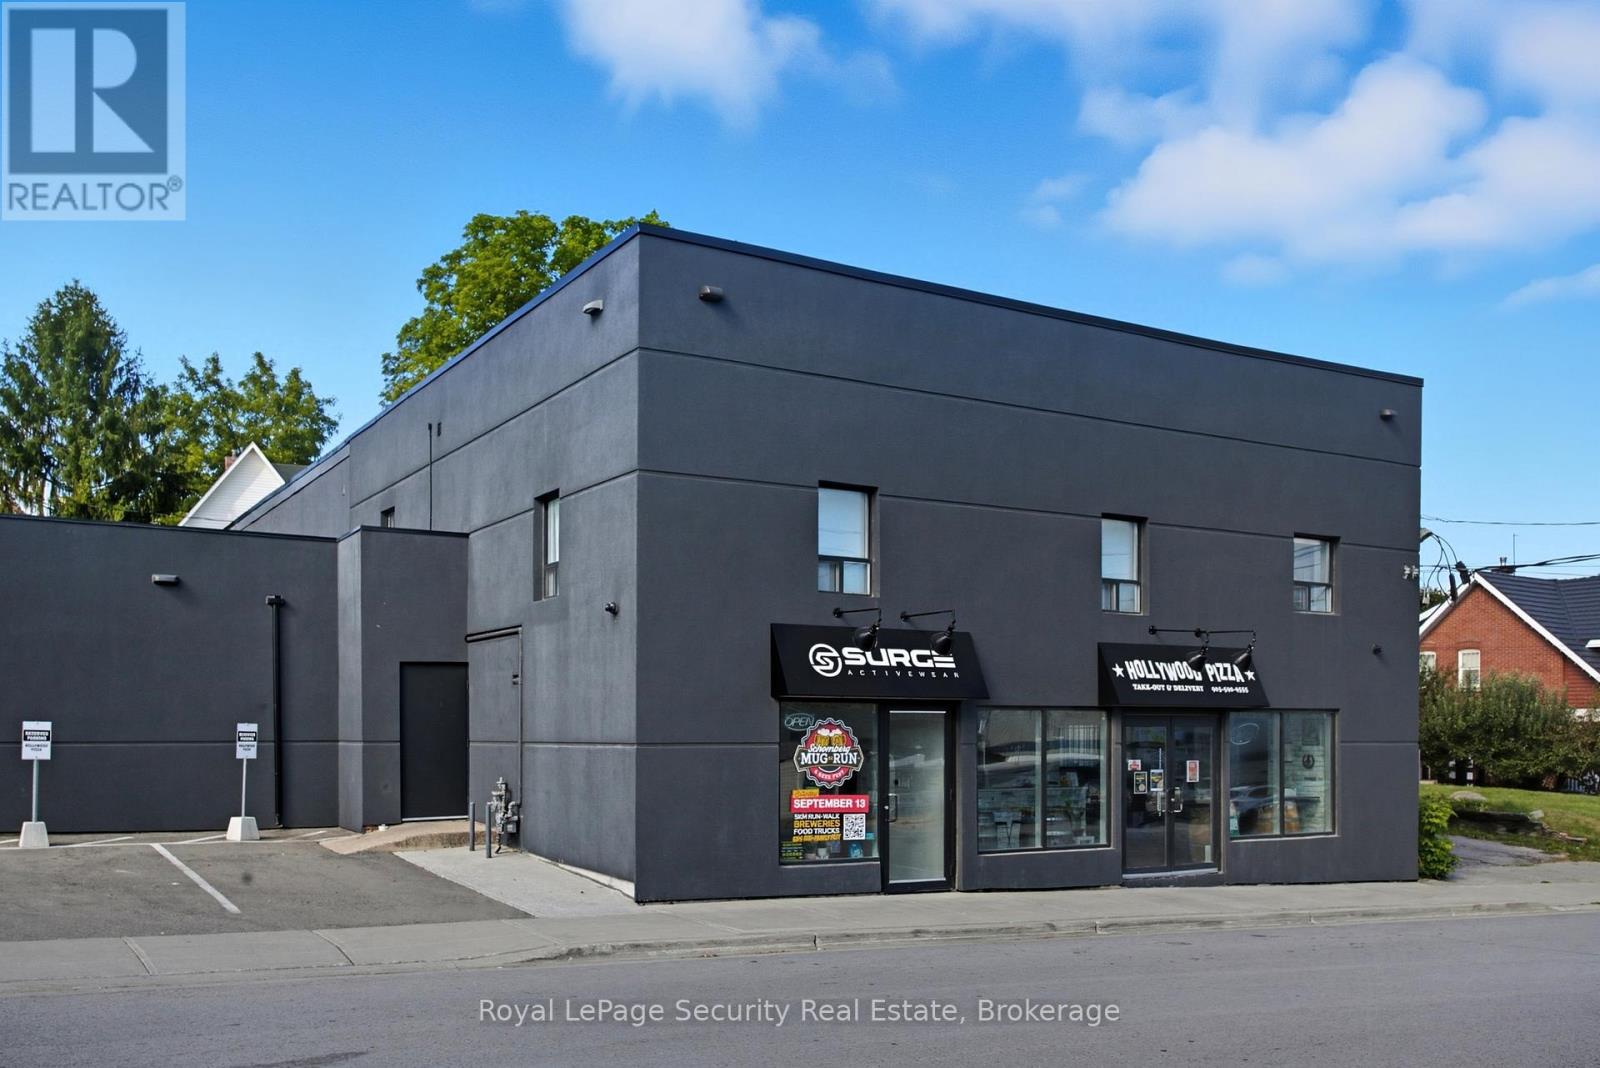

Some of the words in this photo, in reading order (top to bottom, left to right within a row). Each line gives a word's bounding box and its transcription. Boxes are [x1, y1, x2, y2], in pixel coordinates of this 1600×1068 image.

[842, 647, 956, 668] SURGE
[847, 669, 960, 678] ACTIVEWEAR
[1205, 662, 1245, 682] PIZZA
[1132, 683, 1165, 691] TAKE-OUT
[1173, 684, 1204, 692] DELIVERY
[784, 715, 815, 728] OPEN
[808, 744, 851, 756] Schomberg
[800, 752, 828, 765] MUG
[832, 752, 858, 765] RUN
[793, 798, 853, 809] SEPTEMBER
[855, 798, 866, 809] 13
[793, 819, 841, 828] BREWERIES
